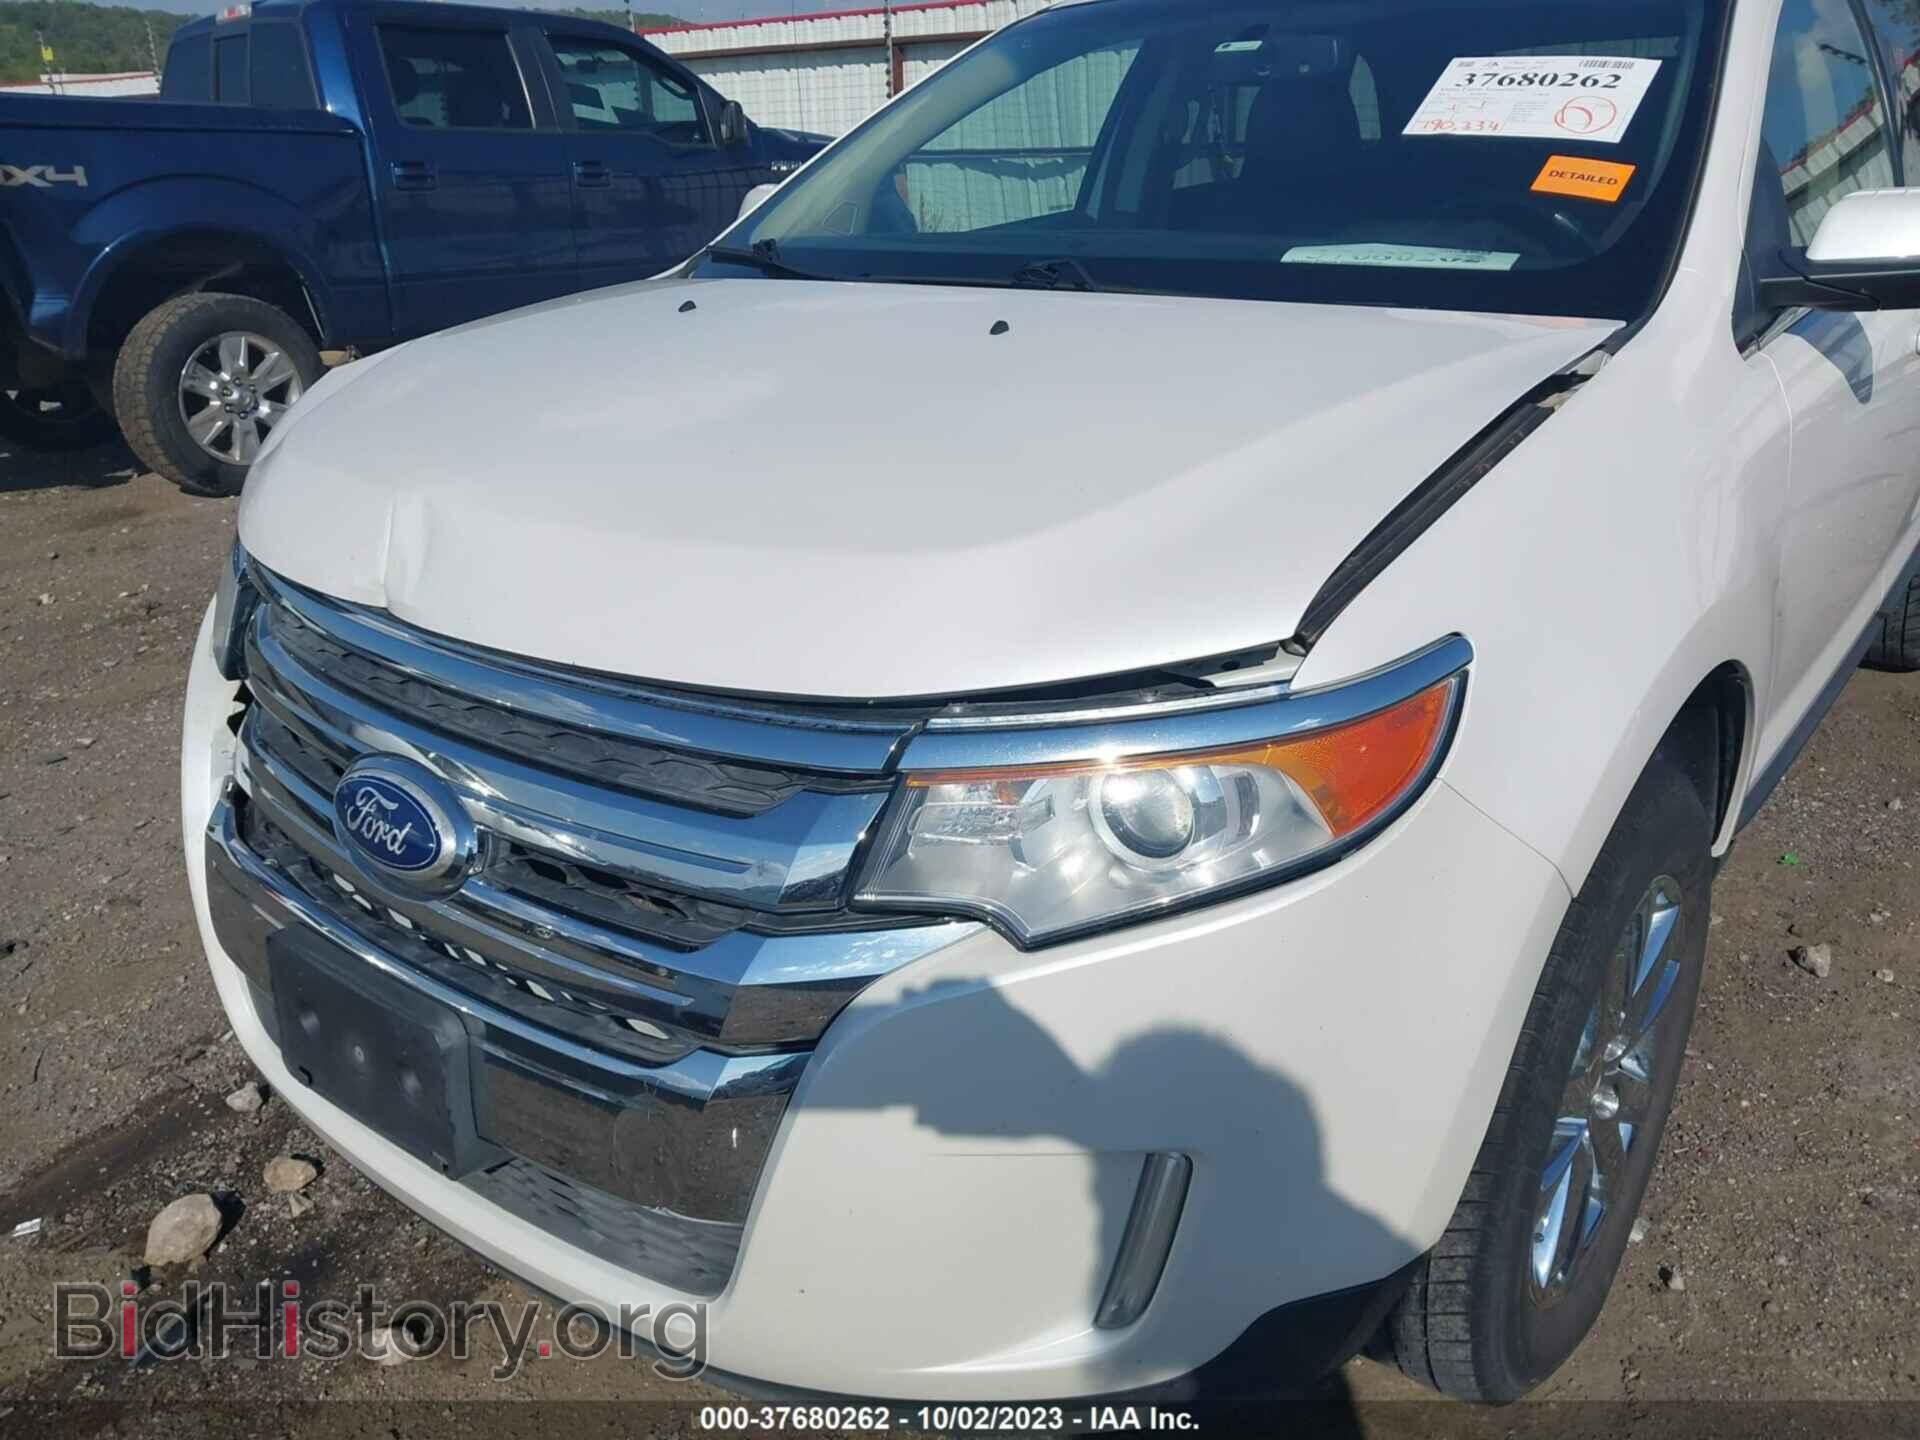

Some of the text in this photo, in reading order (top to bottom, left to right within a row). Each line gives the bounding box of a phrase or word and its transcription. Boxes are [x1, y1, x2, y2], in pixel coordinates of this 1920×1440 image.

[1455, 72, 1622, 89] 37680262
[0, 164, 88, 188] X4
[1548, 169, 1618, 186] DETAILED
[344, 786, 413, 855] Ford
